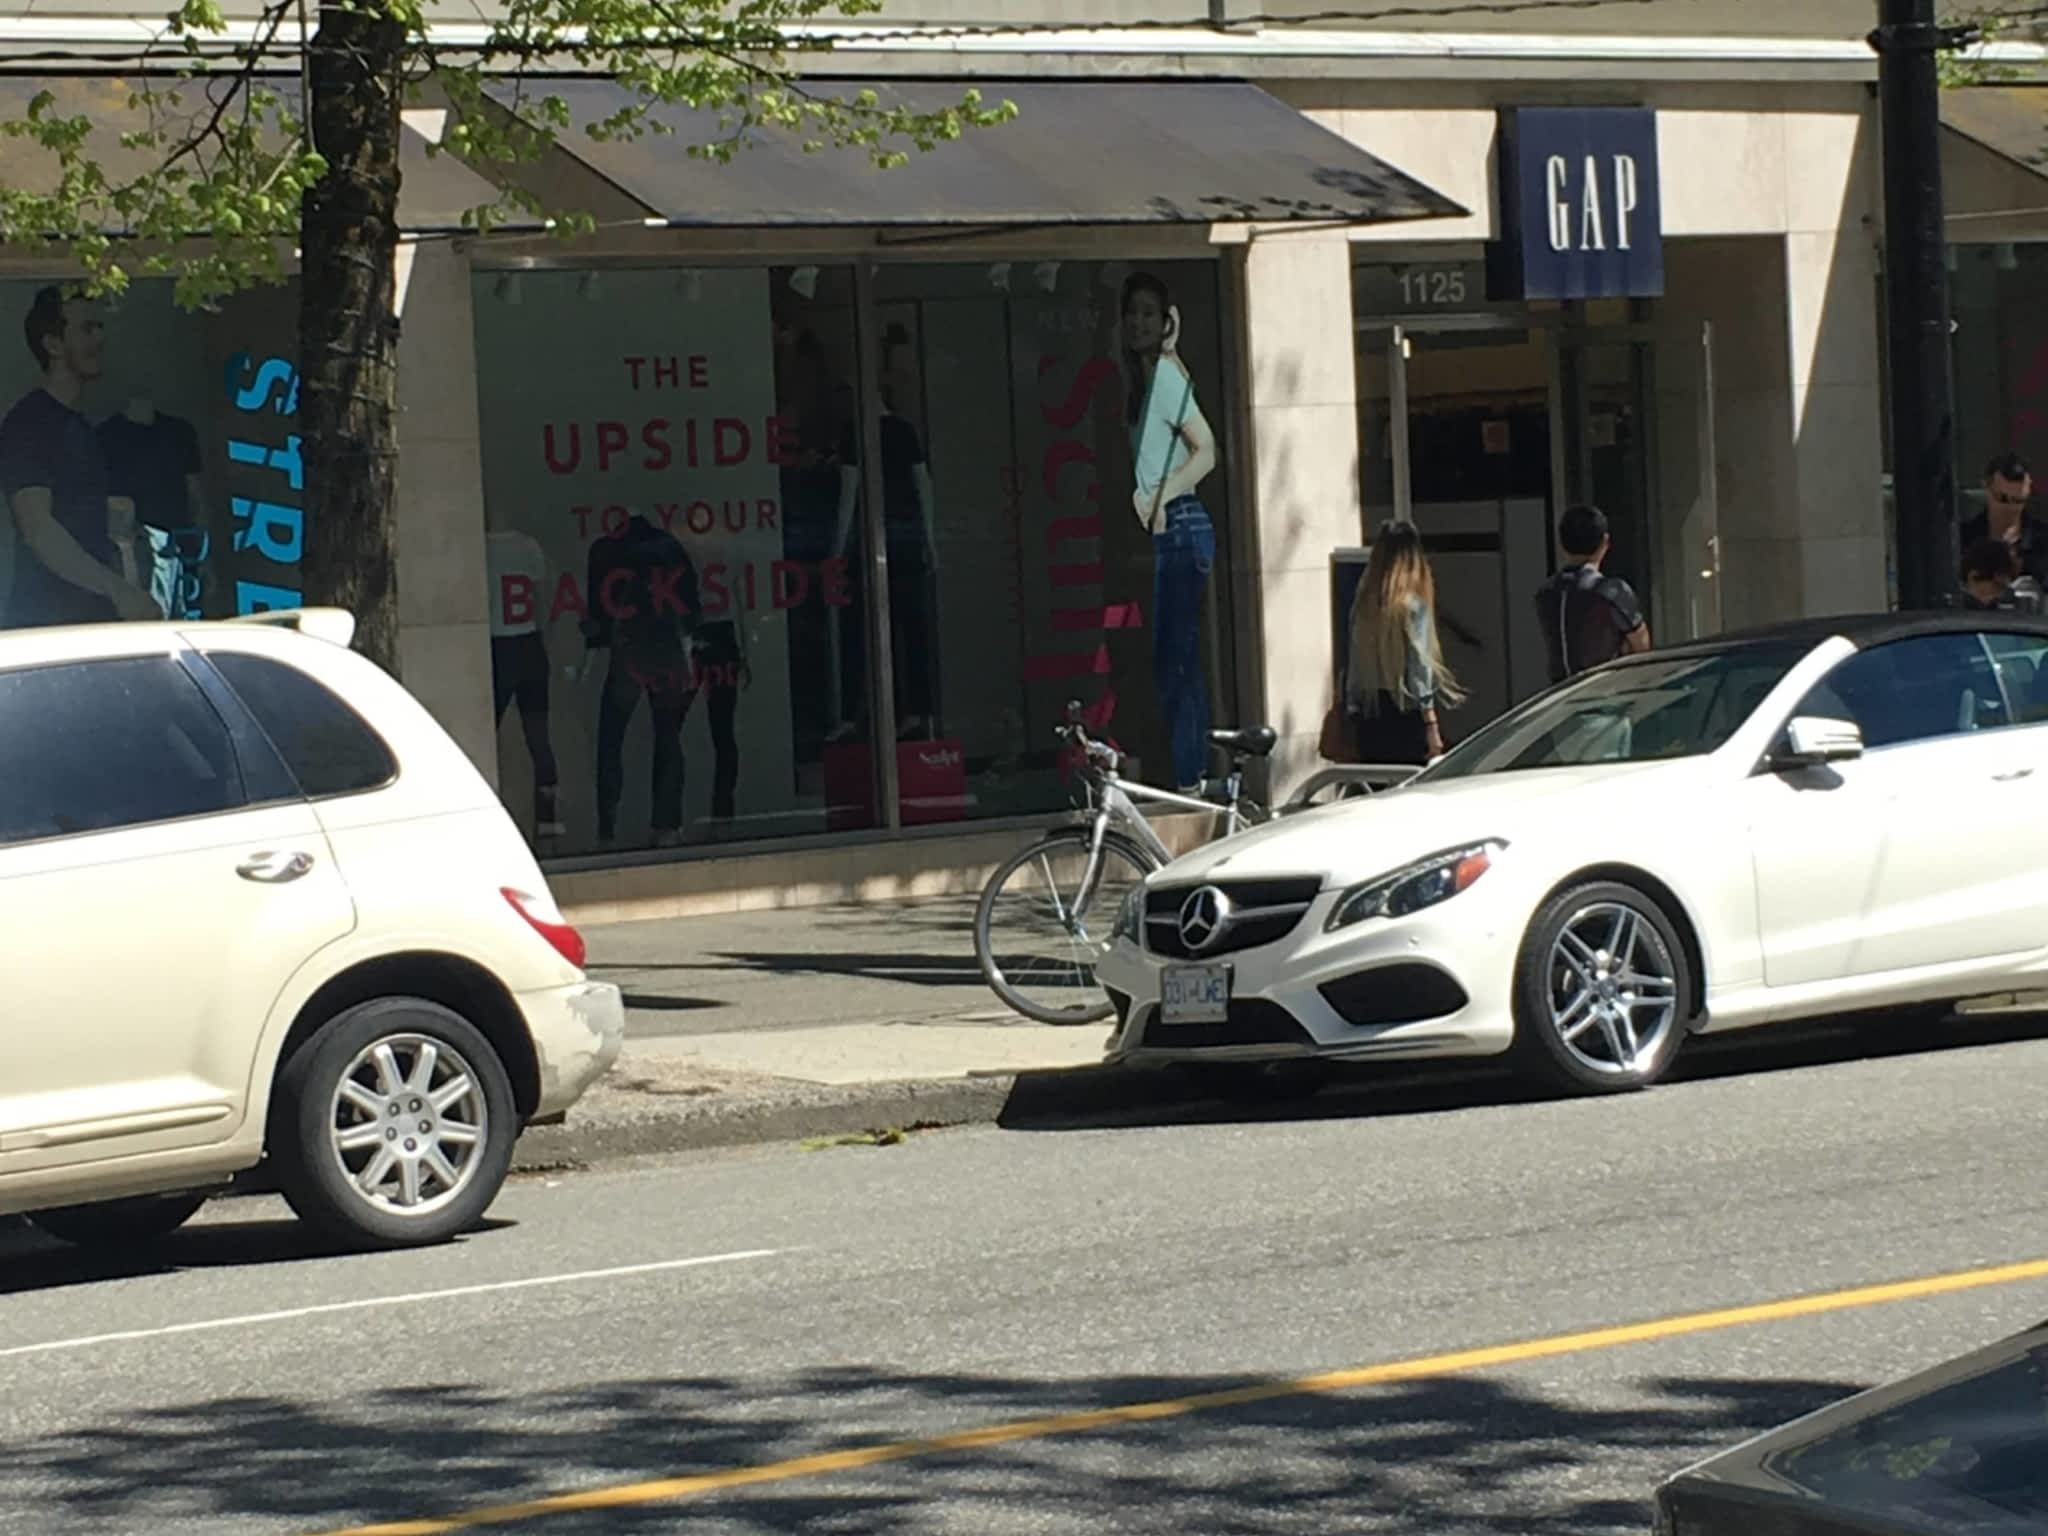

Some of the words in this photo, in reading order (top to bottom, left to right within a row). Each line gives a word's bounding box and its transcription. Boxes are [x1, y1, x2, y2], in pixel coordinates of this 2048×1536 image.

[1546, 154, 1637, 251] GAP
[1398, 271, 1467, 305] 1125
[623, 355, 710, 390] THE
[543, 416, 800, 476] UPSIDE
[571, 505, 629, 538] TO
[655, 499, 778, 534] YOUR
[501, 556, 855, 625] BACKSIDE
